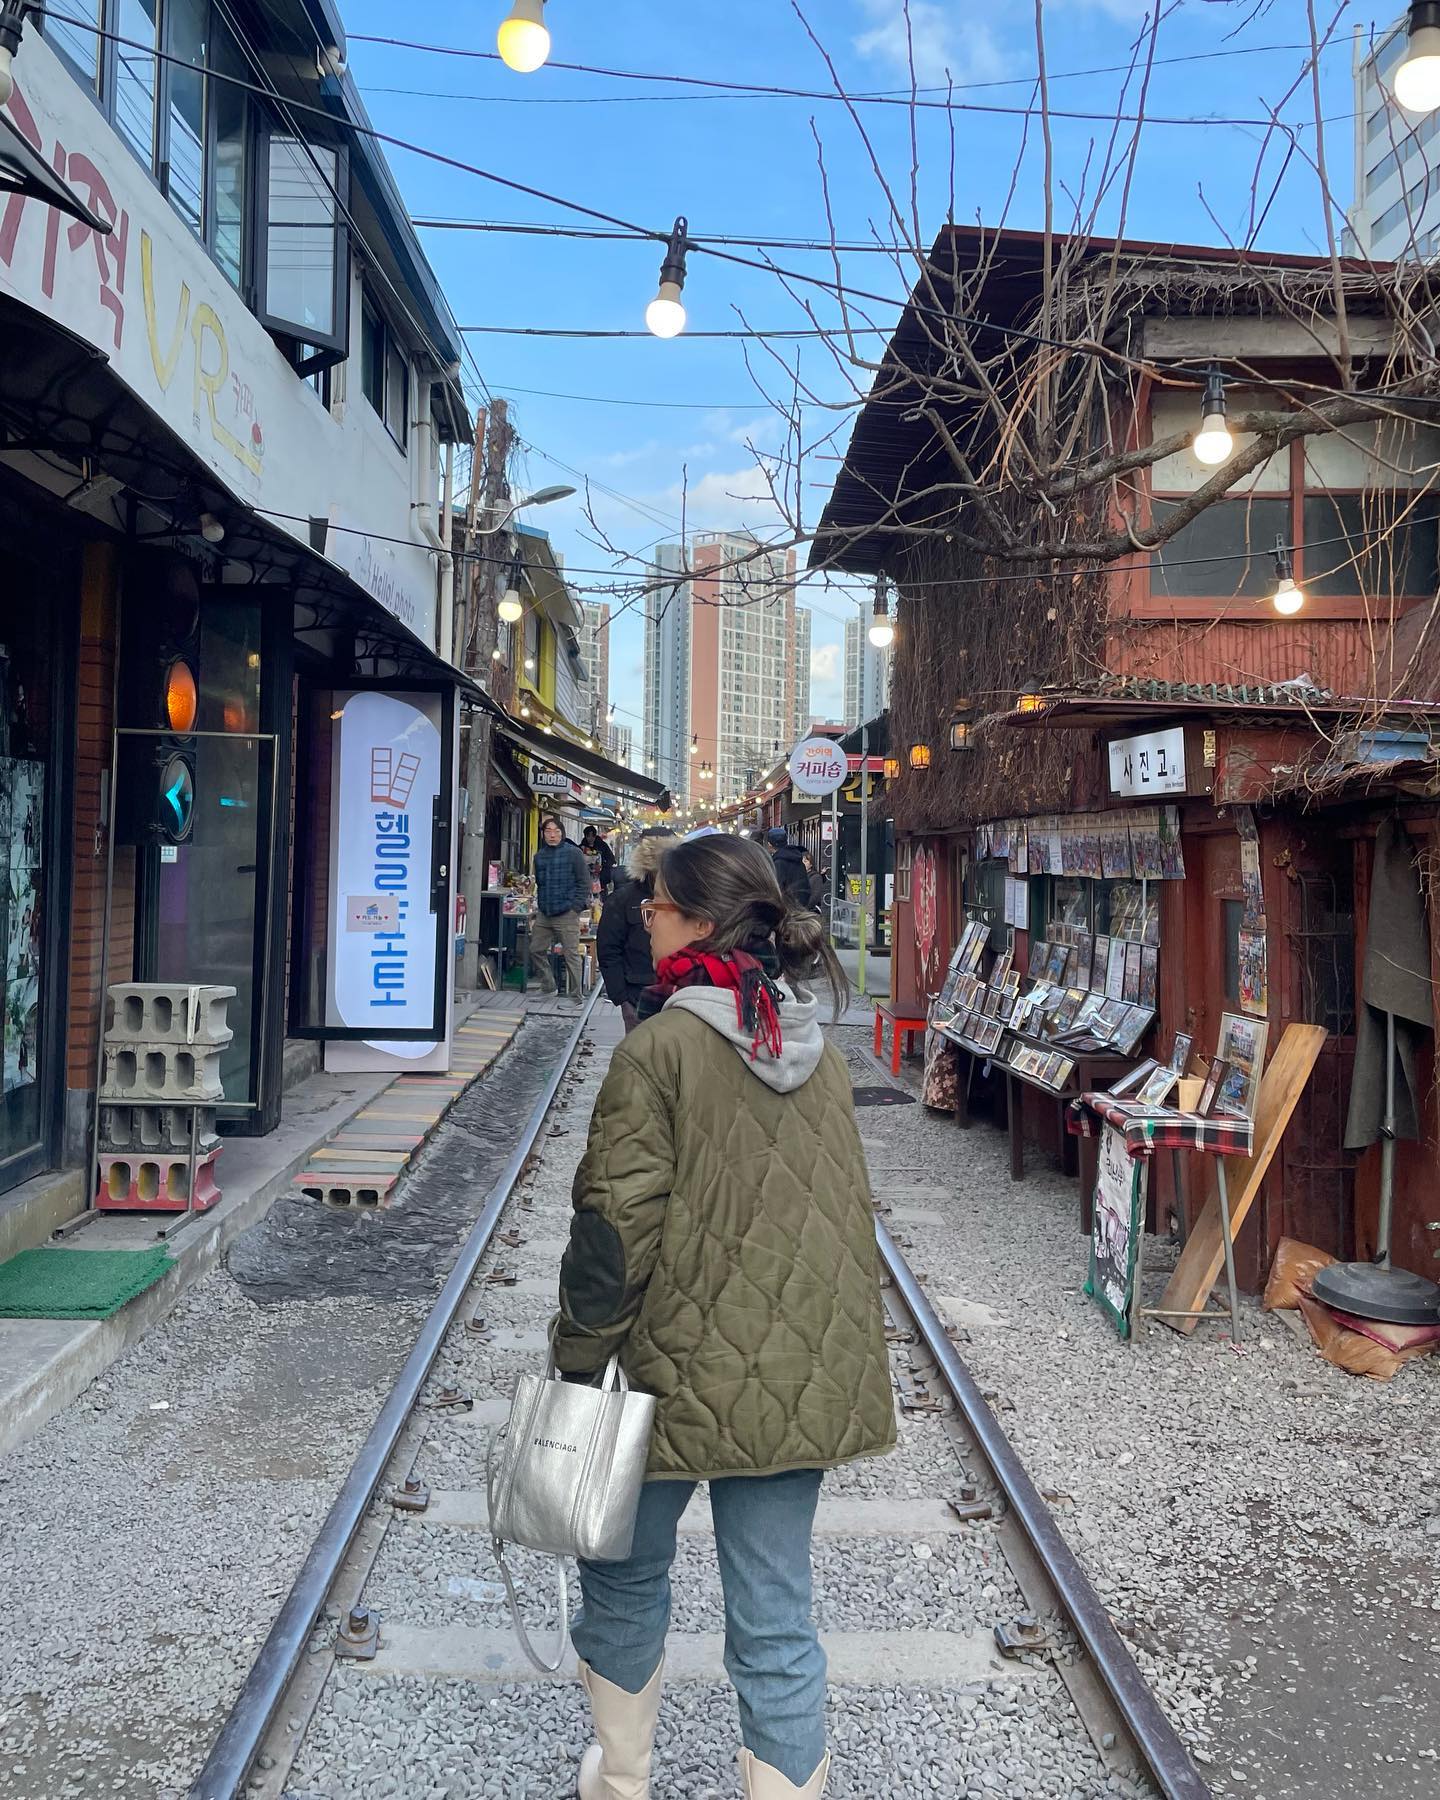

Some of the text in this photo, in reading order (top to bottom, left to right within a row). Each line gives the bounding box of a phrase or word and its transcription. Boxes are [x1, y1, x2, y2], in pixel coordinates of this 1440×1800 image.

[140, 228, 263, 477] VR
[371, 562, 415, 625] Hello! photo
[797, 761, 842, 778] 커피숍
